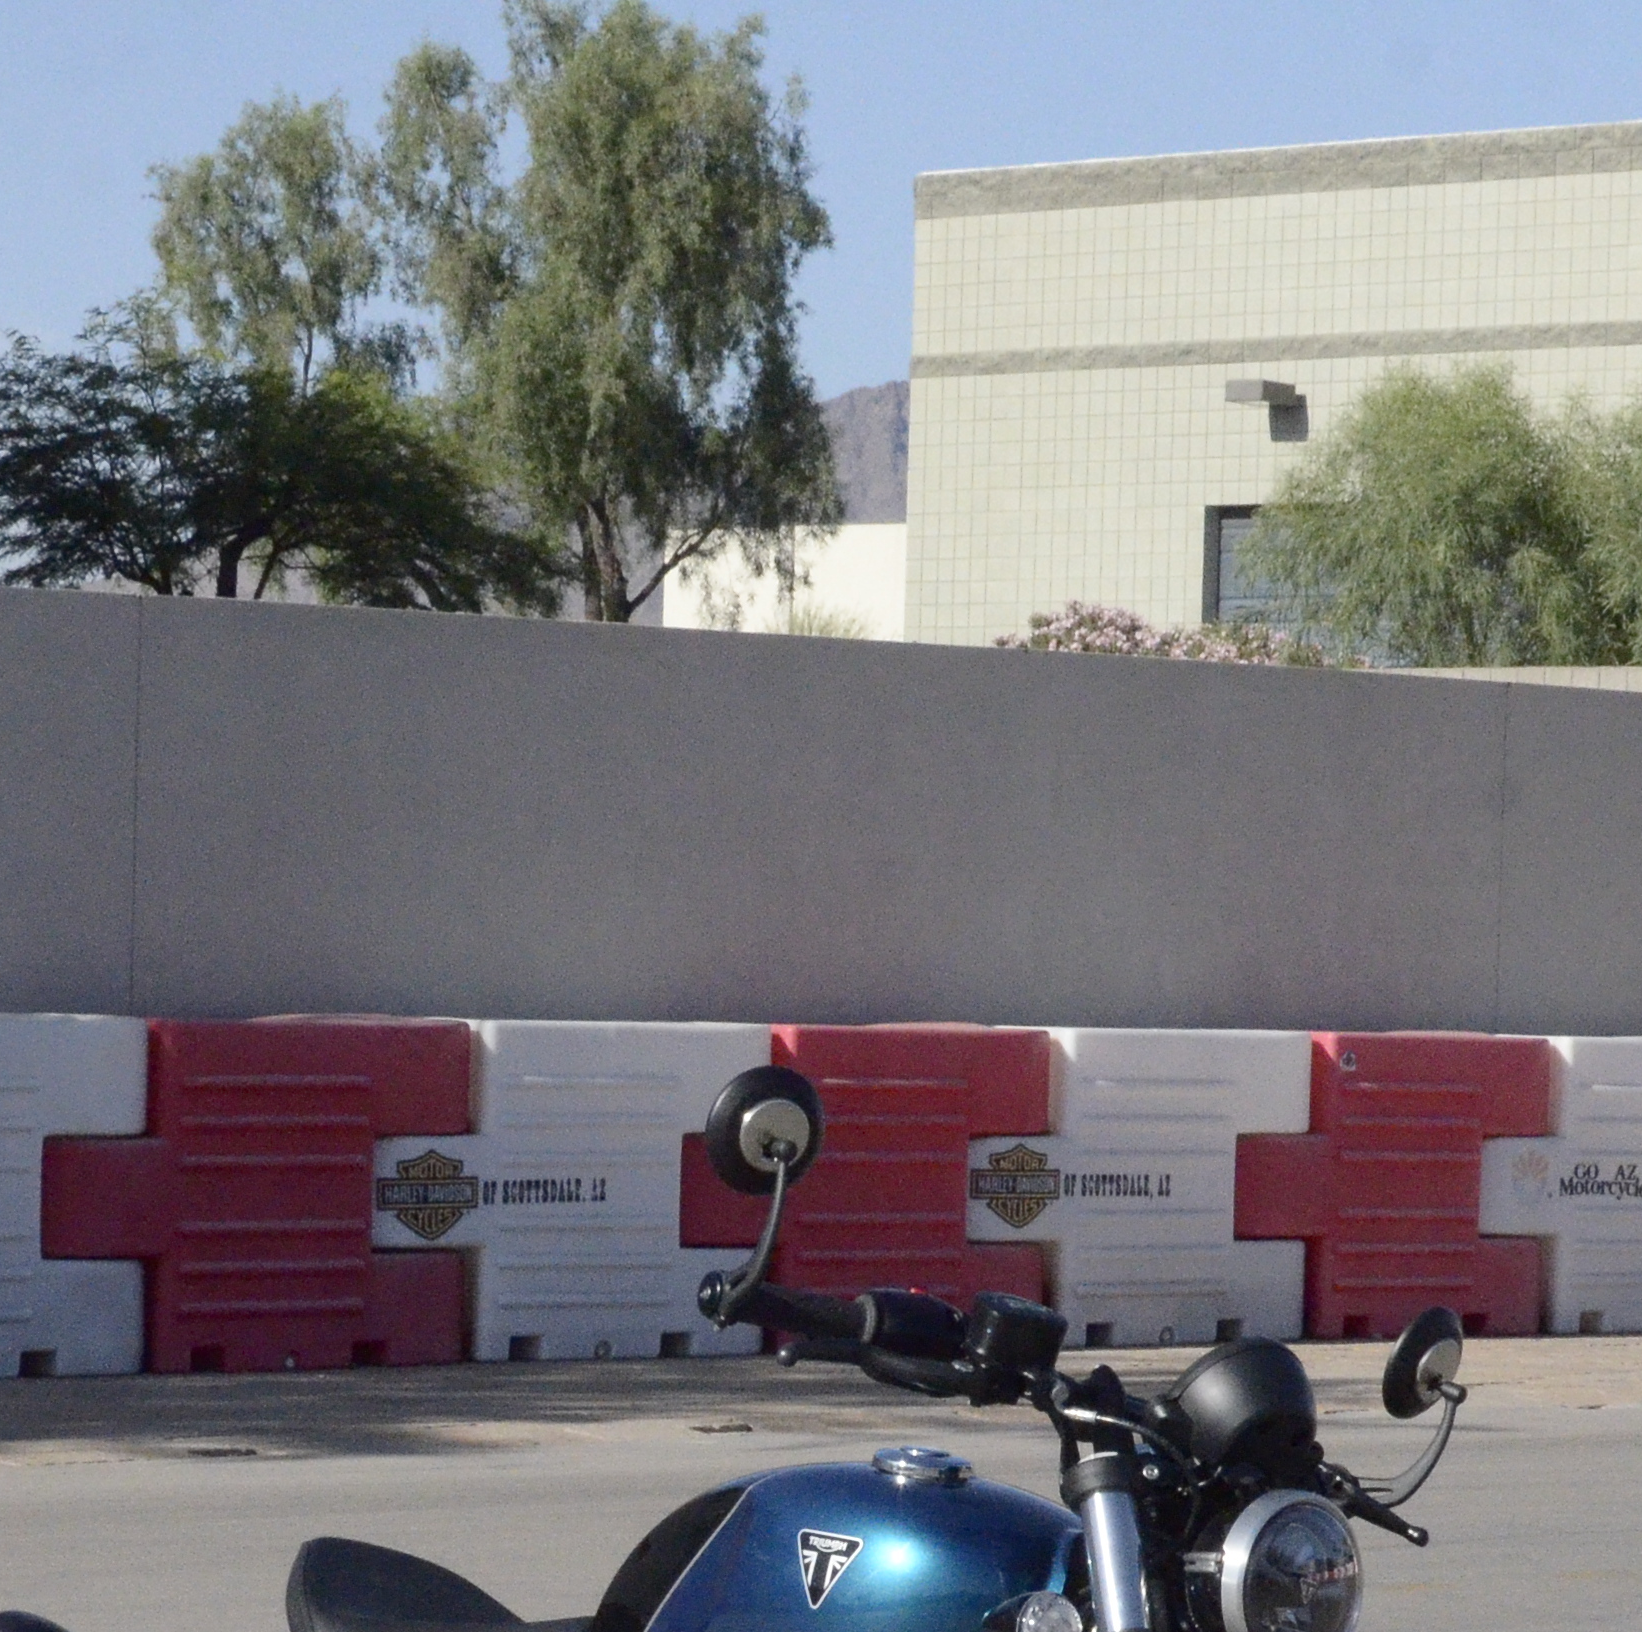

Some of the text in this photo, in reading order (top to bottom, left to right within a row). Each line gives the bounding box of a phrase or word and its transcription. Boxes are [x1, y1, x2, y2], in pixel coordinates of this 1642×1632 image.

[1574, 1163, 1638, 1181] GO AZ
[482, 1180, 497, 1205] OF
[1064, 1174, 1077, 1197] OF
[1158, 1174, 1171, 1197] AZ
[808, 1535, 849, 1552] TRIUMPH
